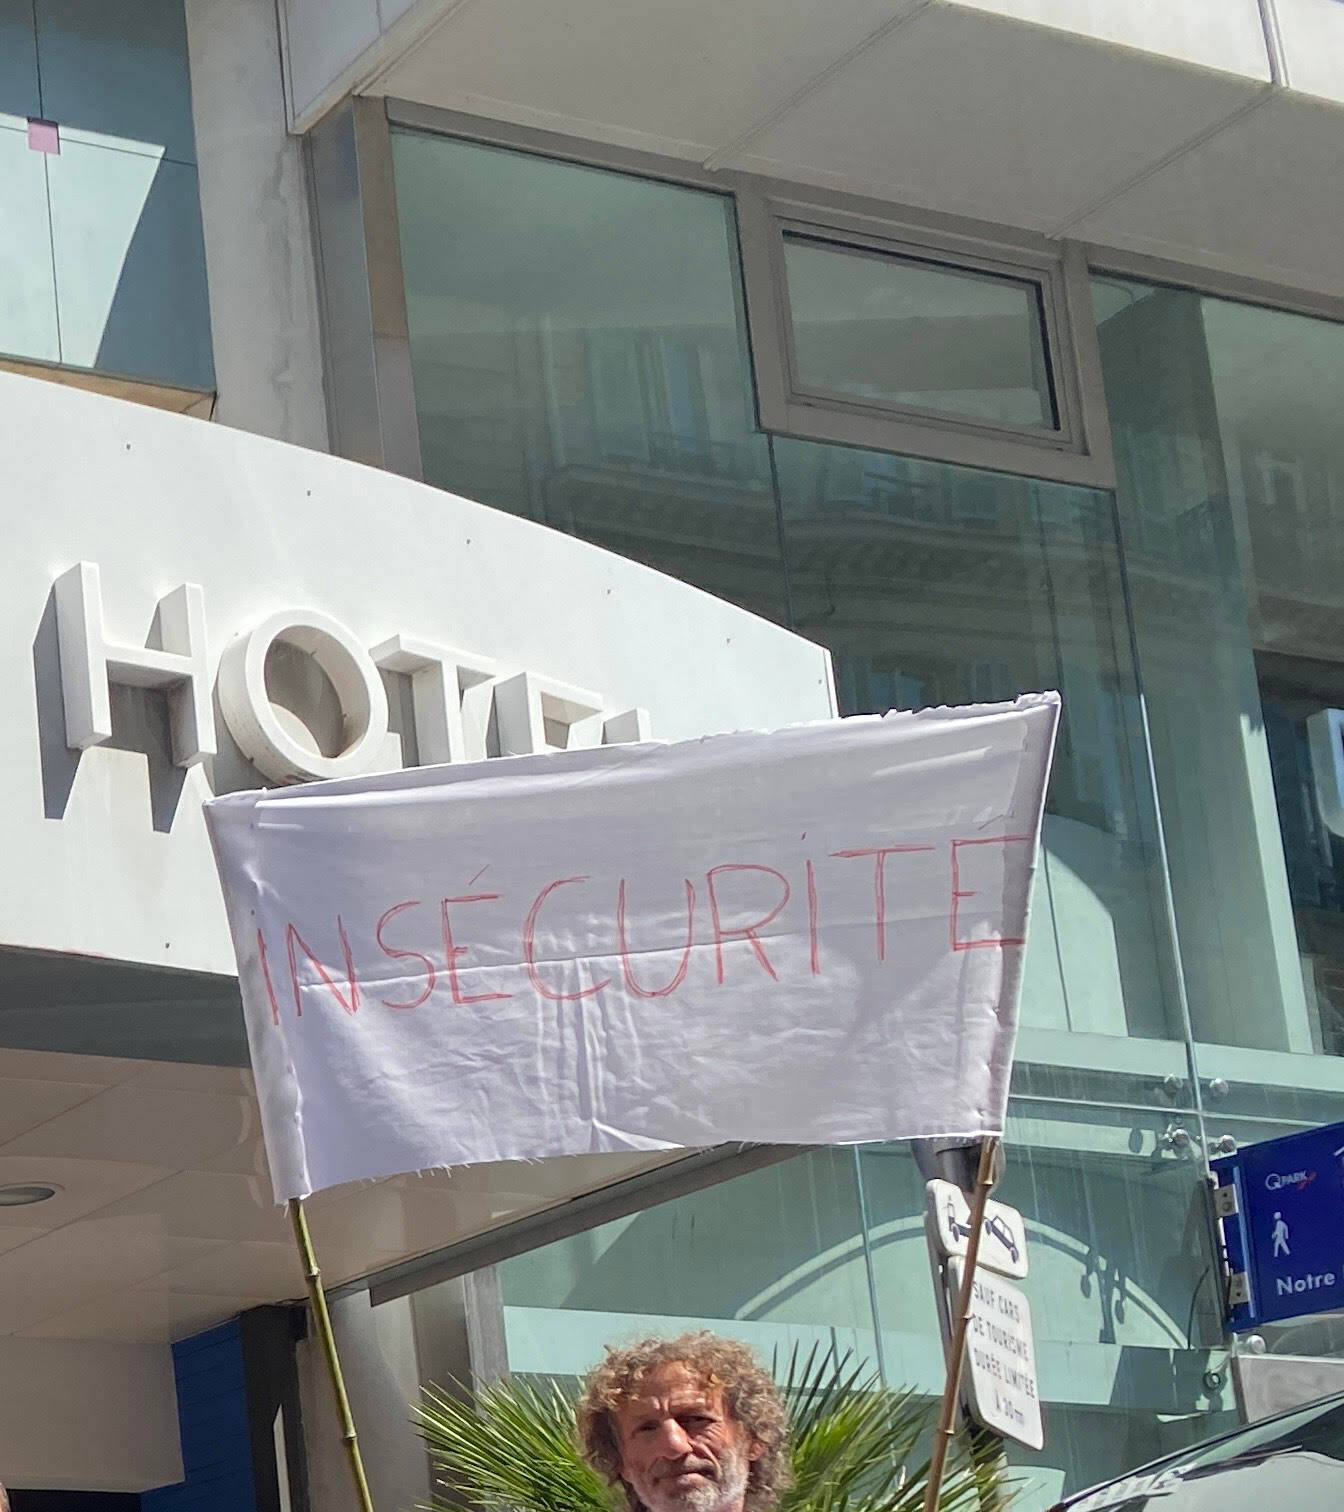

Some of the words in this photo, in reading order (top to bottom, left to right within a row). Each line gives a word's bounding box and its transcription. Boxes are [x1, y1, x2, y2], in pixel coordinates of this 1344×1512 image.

[55, 560, 650, 790] HOT
[1276, 1271, 1337, 1297] Notre
[986, 1320, 1030, 1362] TOURISME
